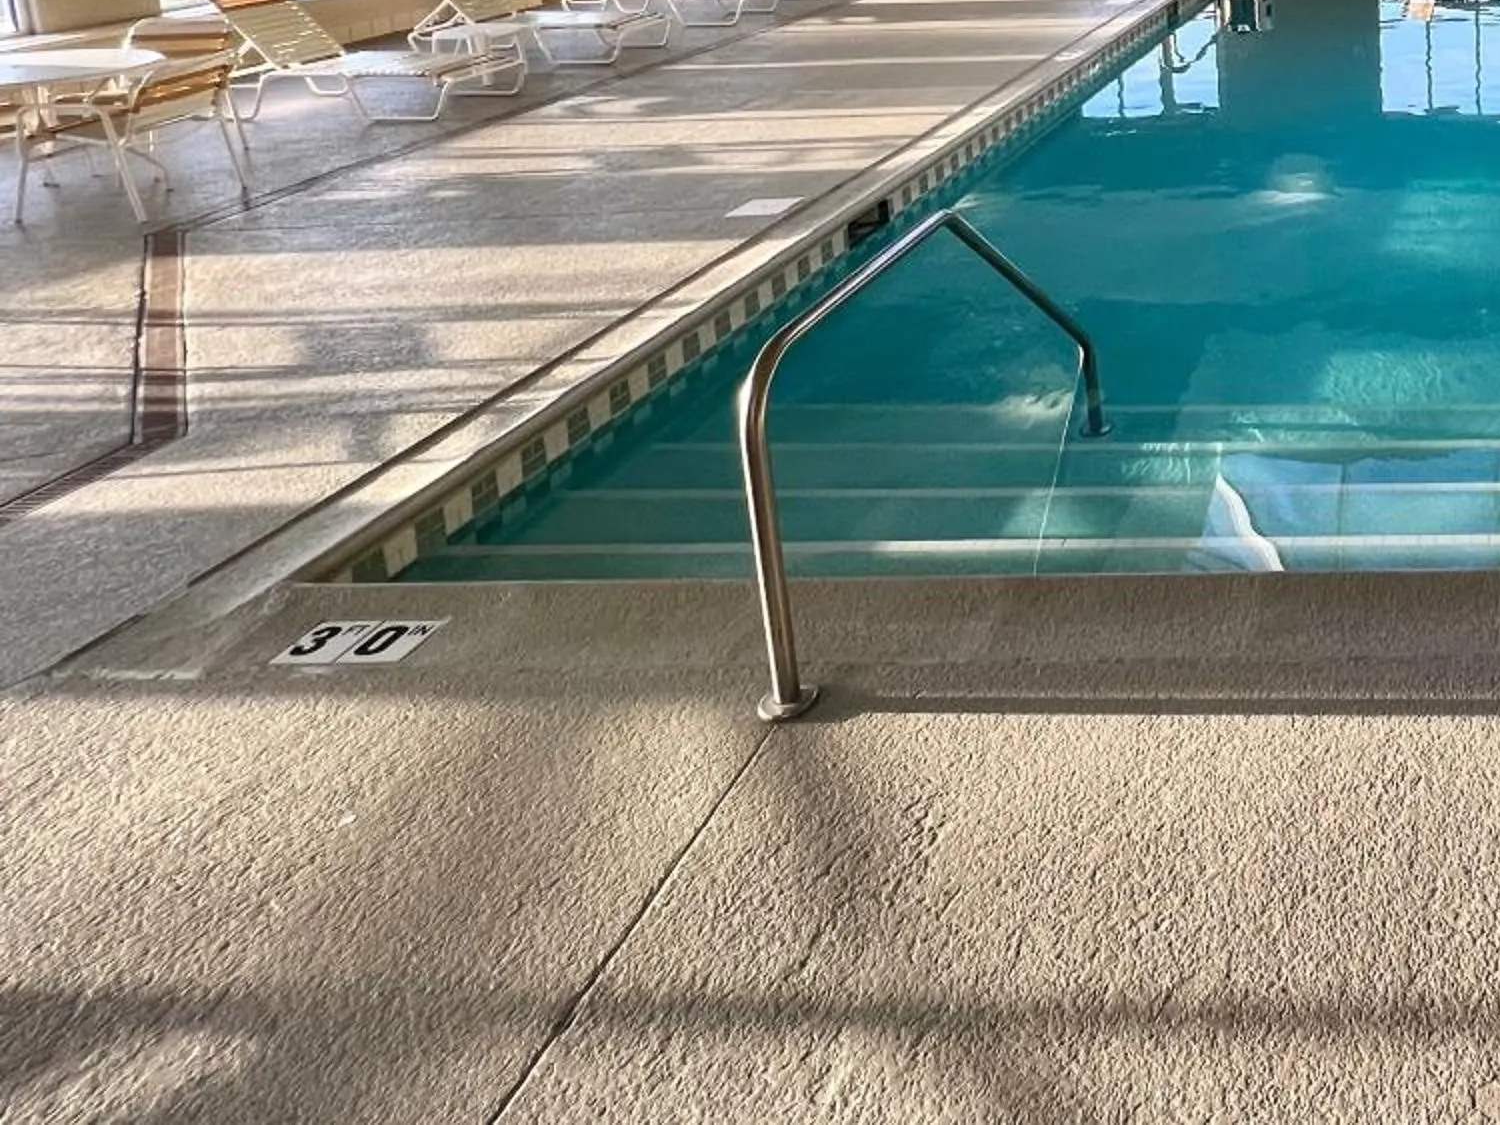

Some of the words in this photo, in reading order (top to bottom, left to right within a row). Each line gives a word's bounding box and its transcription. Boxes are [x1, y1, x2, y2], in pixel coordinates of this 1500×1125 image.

[289, 626, 343, 655] 3
[353, 626, 409, 655] 0
[407, 625, 434, 636] IN
